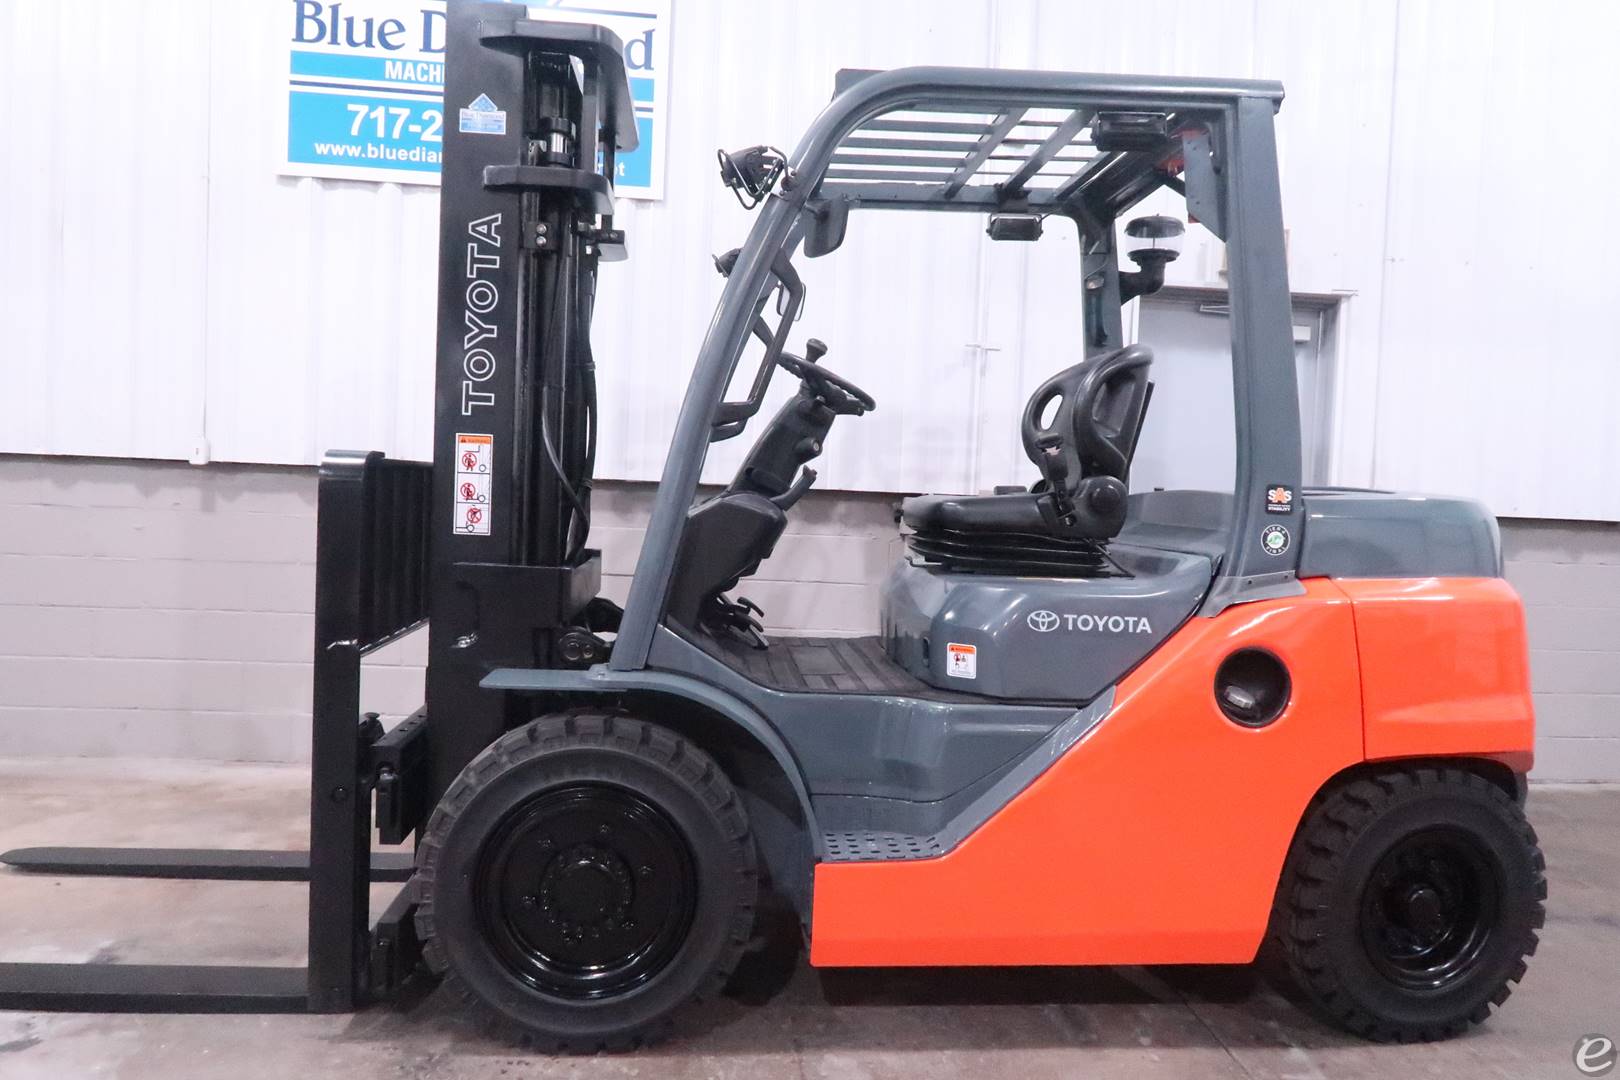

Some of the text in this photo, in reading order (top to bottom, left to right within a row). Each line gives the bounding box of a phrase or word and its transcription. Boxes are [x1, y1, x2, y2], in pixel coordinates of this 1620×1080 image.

[291, 0, 406, 51] Blue
[347, 103, 443, 142] 717-2
[314, 142, 443, 164] www.bluedia
[462, 208, 502, 415] TOYOTA
[1268, 487, 1292, 504] SAS
[1063, 614, 1152, 634] TOYOTA
